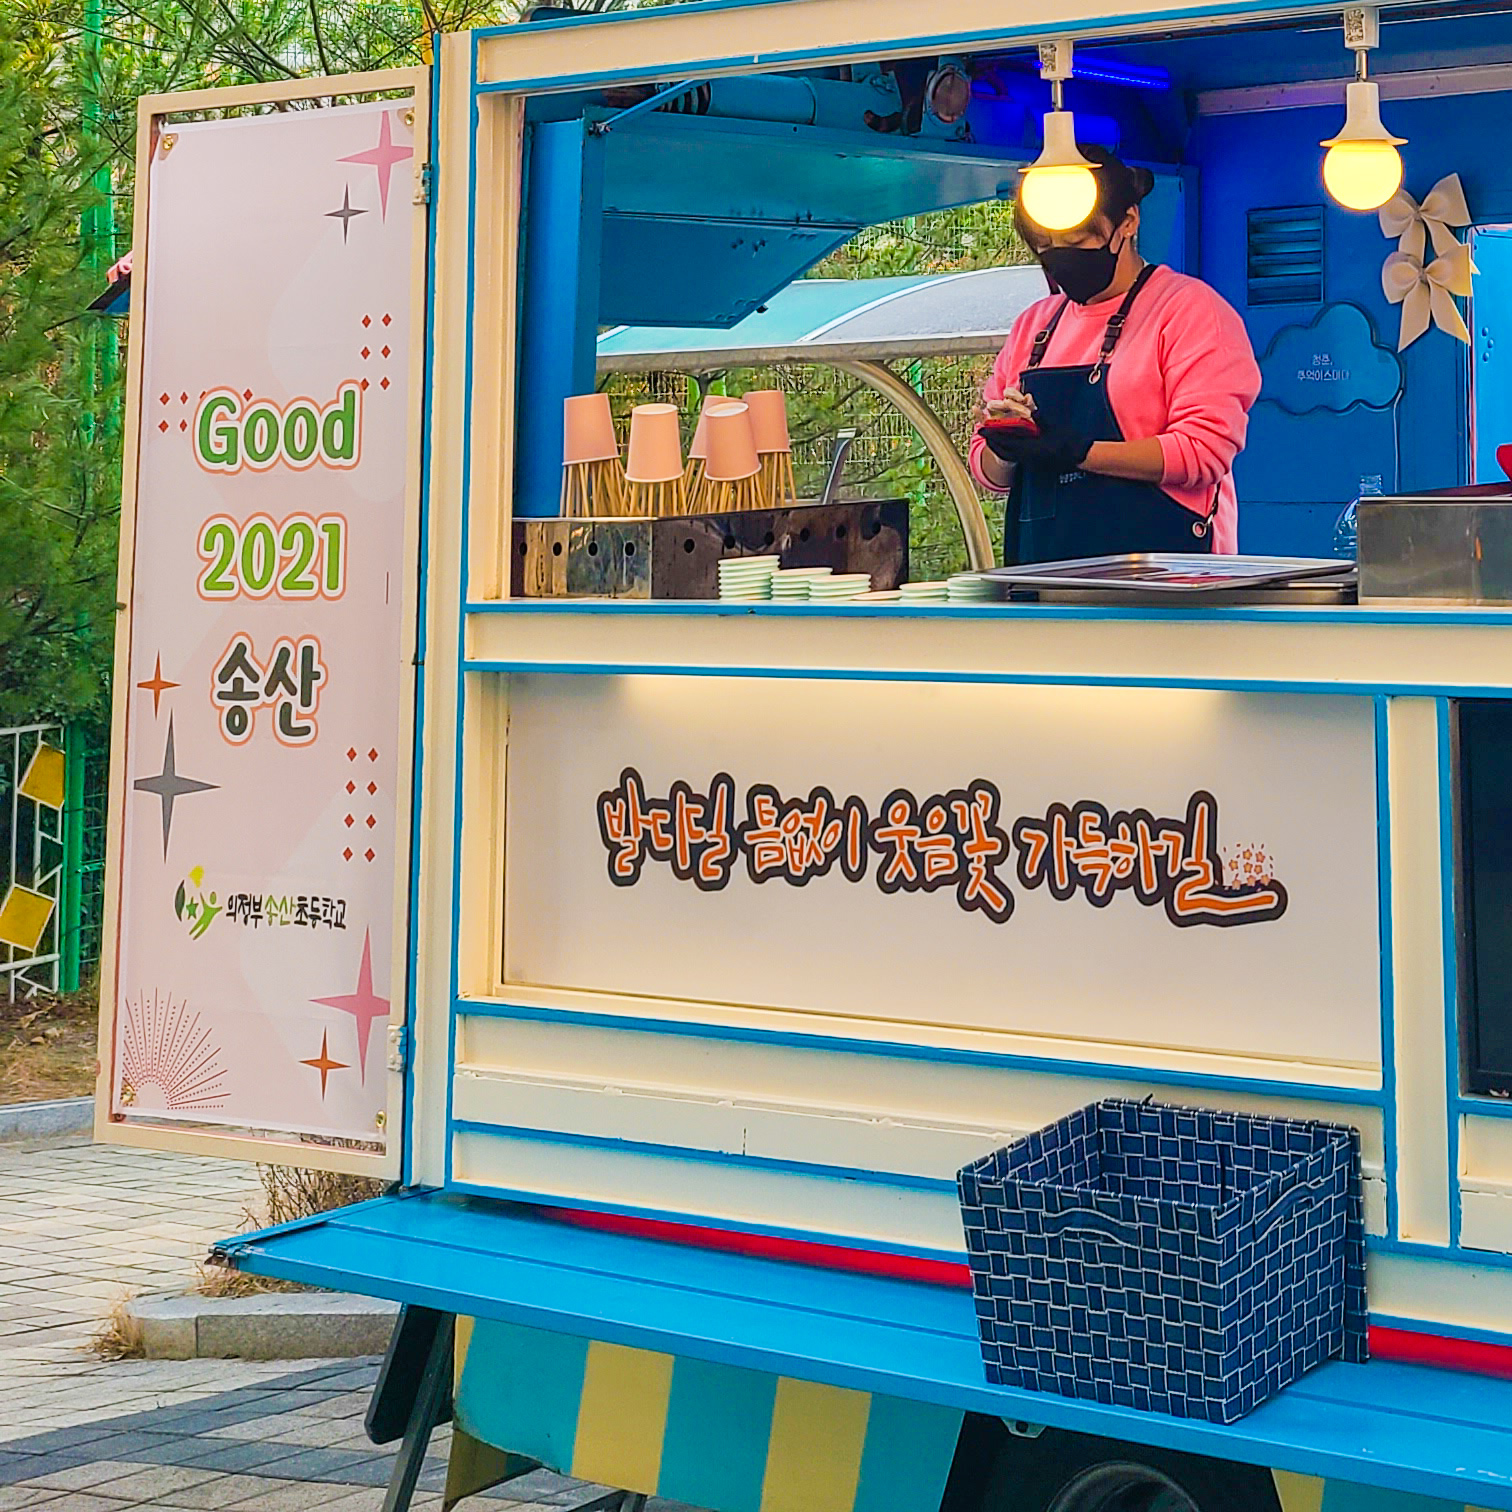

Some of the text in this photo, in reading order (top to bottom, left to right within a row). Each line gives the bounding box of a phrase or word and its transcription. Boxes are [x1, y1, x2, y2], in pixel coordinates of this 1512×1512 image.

[196, 382, 361, 473] Good
[199, 515, 346, 599] 2021
[214, 635, 326, 745] 송산
[870, 780, 1013, 922] 웃음꽃
[1015, 791, 1287, 926] 가득하길
